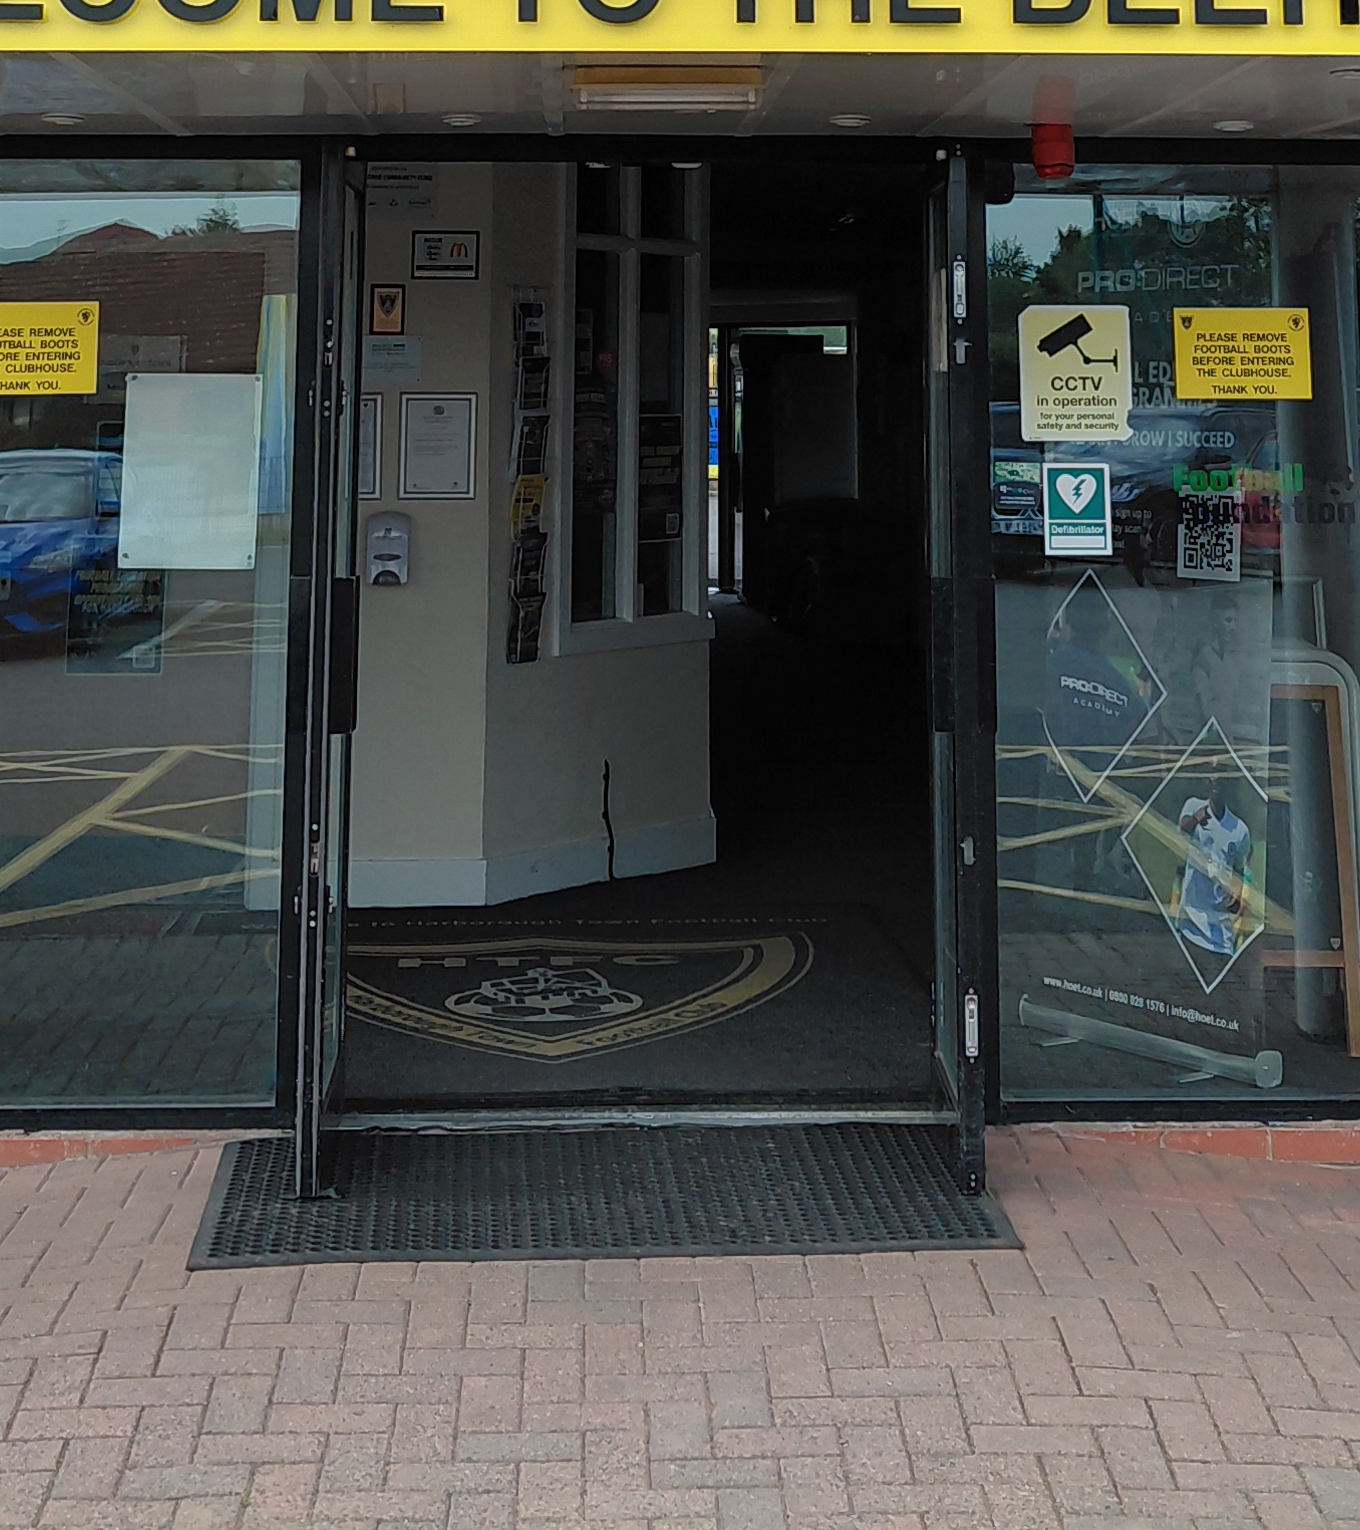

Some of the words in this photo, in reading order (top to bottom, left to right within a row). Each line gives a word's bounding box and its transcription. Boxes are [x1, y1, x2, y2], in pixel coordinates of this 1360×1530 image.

[29, 327, 76, 337] REMOVE
[1196, 332, 1238, 342] PLEASE
[1242, 332, 1288, 342] REMOVE
[40, 339, 79, 349] BOOTS
[1193, 345, 1249, 354] FOOTBALL
[1253, 345, 1292, 354] BOOTS
[25, 351, 81, 361] ENTERING
[1192, 356, 1236, 366] BEFORE
[1240, 356, 1295, 366] ENTERING
[5, 363, 77, 373] CLUBHOUSE.
[1196, 368, 1217, 378] THE
[1221, 368, 1292, 378] CLUBHOUSE.
[35, 381, 61, 390] YOU.
[1050, 376, 1103, 391] CCTV
[1211, 385, 1249, 395] THANK
[1252, 385, 1278, 395] YOU.
[1036, 395, 1049, 407] in
[1052, 395, 1118, 409] operation
[1040, 412, 1052, 420] for
[1054, 413, 1075, 421] your
[1076, 412, 1115, 421] personal
[1036, 421, 1064, 431] safety
[1065, 422, 1082, 430] and
[1083, 421, 1120, 431] security
[1175, 430, 1236, 449] SUCCEED
[1172, 463, 1304, 492] Football
[1050, 524, 1106, 535] Defibrillator
[397, 955, 680, 969] HTFC
[1146, 998, 1165, 1014] 1576
[1171, 1003, 1240, 1033] info@hoet.co.uk
